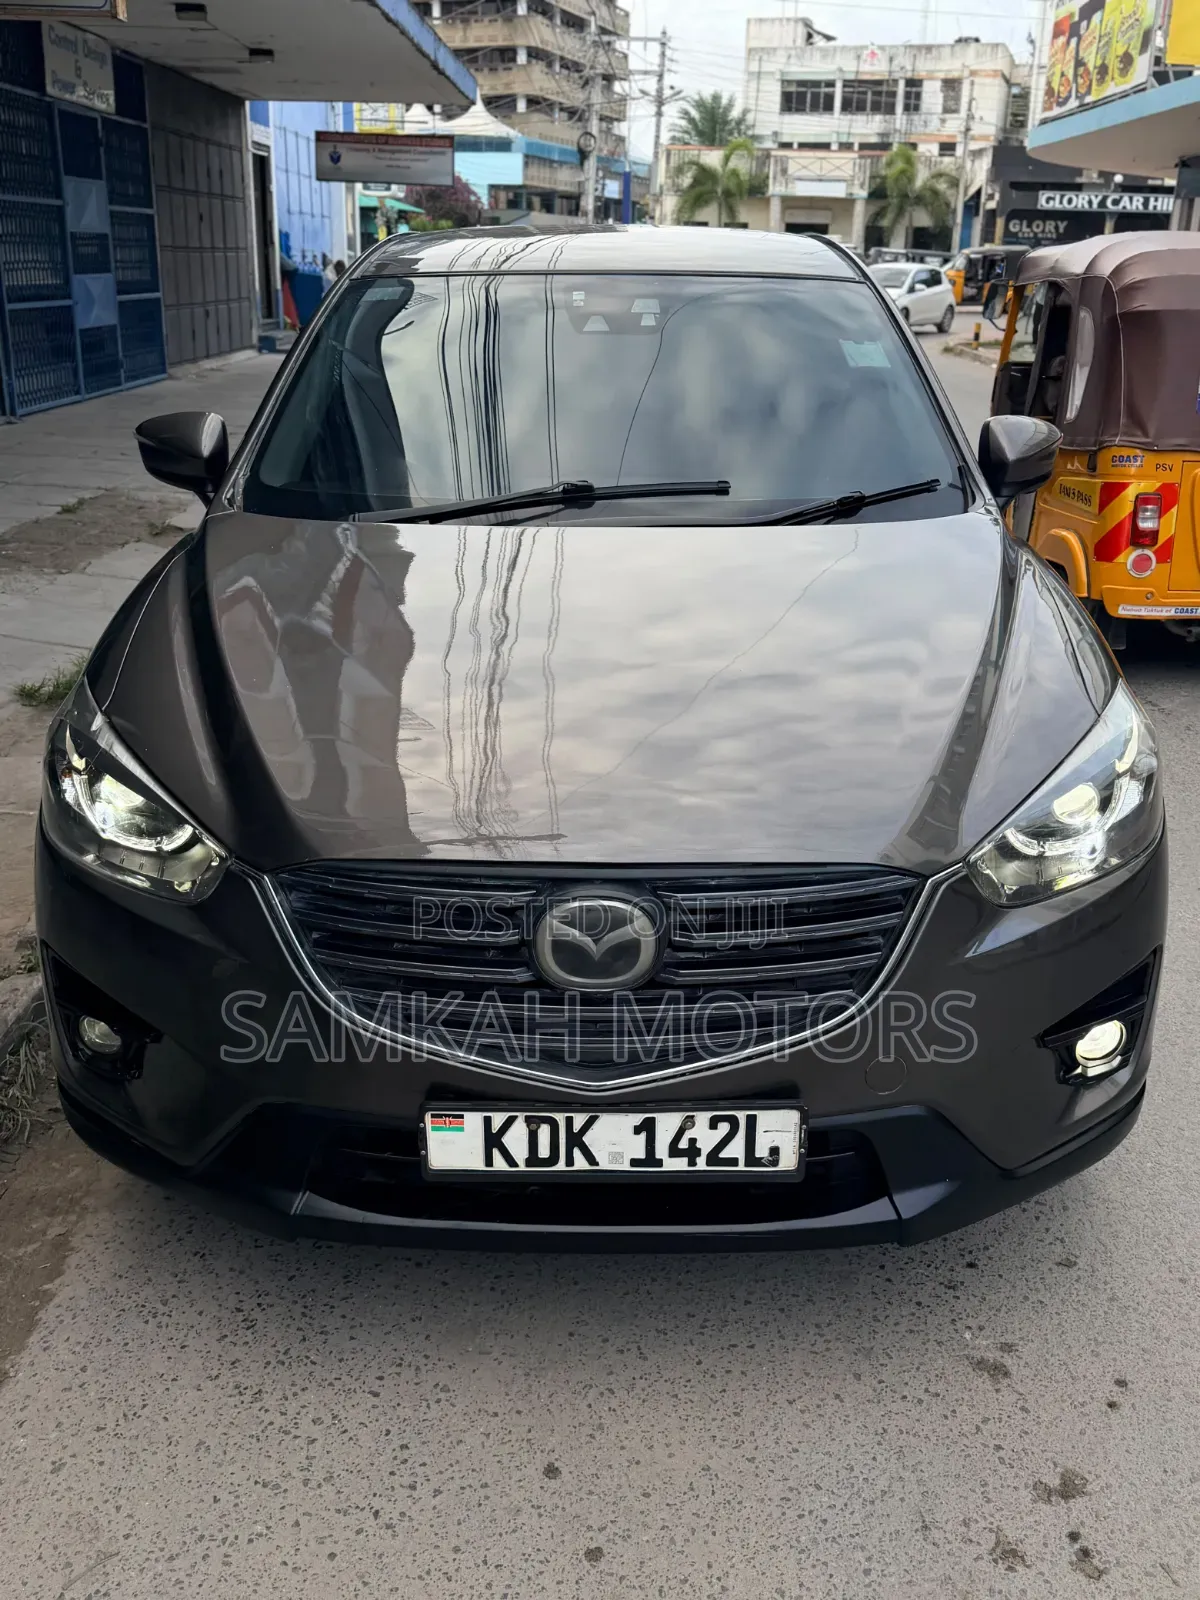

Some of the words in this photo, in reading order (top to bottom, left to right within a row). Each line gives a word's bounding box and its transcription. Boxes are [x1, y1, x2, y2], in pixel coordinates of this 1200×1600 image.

[1041, 191, 1103, 209] GLORY
[1106, 194, 1144, 210] CAR
[1008, 219, 1068, 234] GLORY
[1111, 454, 1145, 463] COAST
[1155, 463, 1174, 472] PSV
[483, 1114, 600, 1168] KDK
[629, 1113, 780, 1168] 142L
